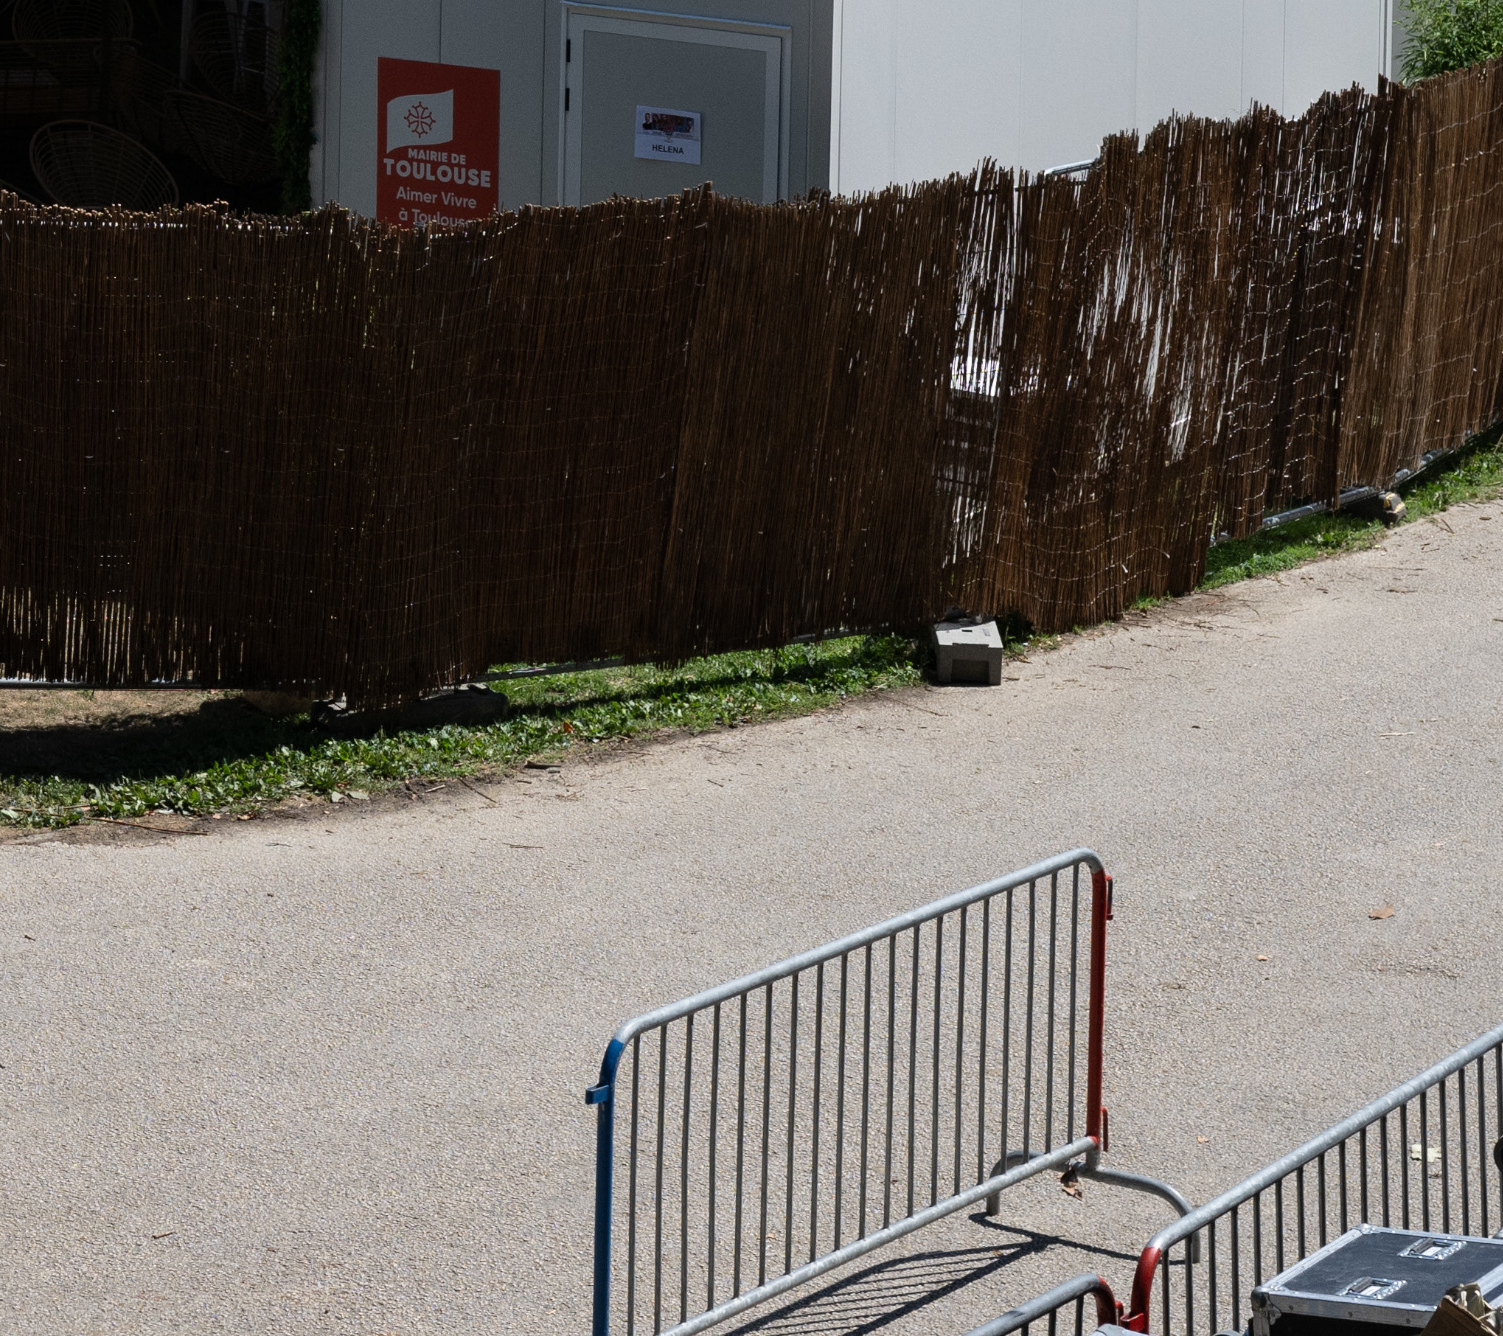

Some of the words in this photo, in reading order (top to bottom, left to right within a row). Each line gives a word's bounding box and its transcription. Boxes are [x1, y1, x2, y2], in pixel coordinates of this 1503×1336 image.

[408, 148, 448, 163] MAIRIE
[451, 153, 467, 165] DE
[652, 144, 684, 155] HELENA
[383, 158, 491, 188] TOULOUSE
[396, 186, 438, 204] Aimer
[441, 191, 477, 209] Vivre
[398, 207, 408, 221] à
